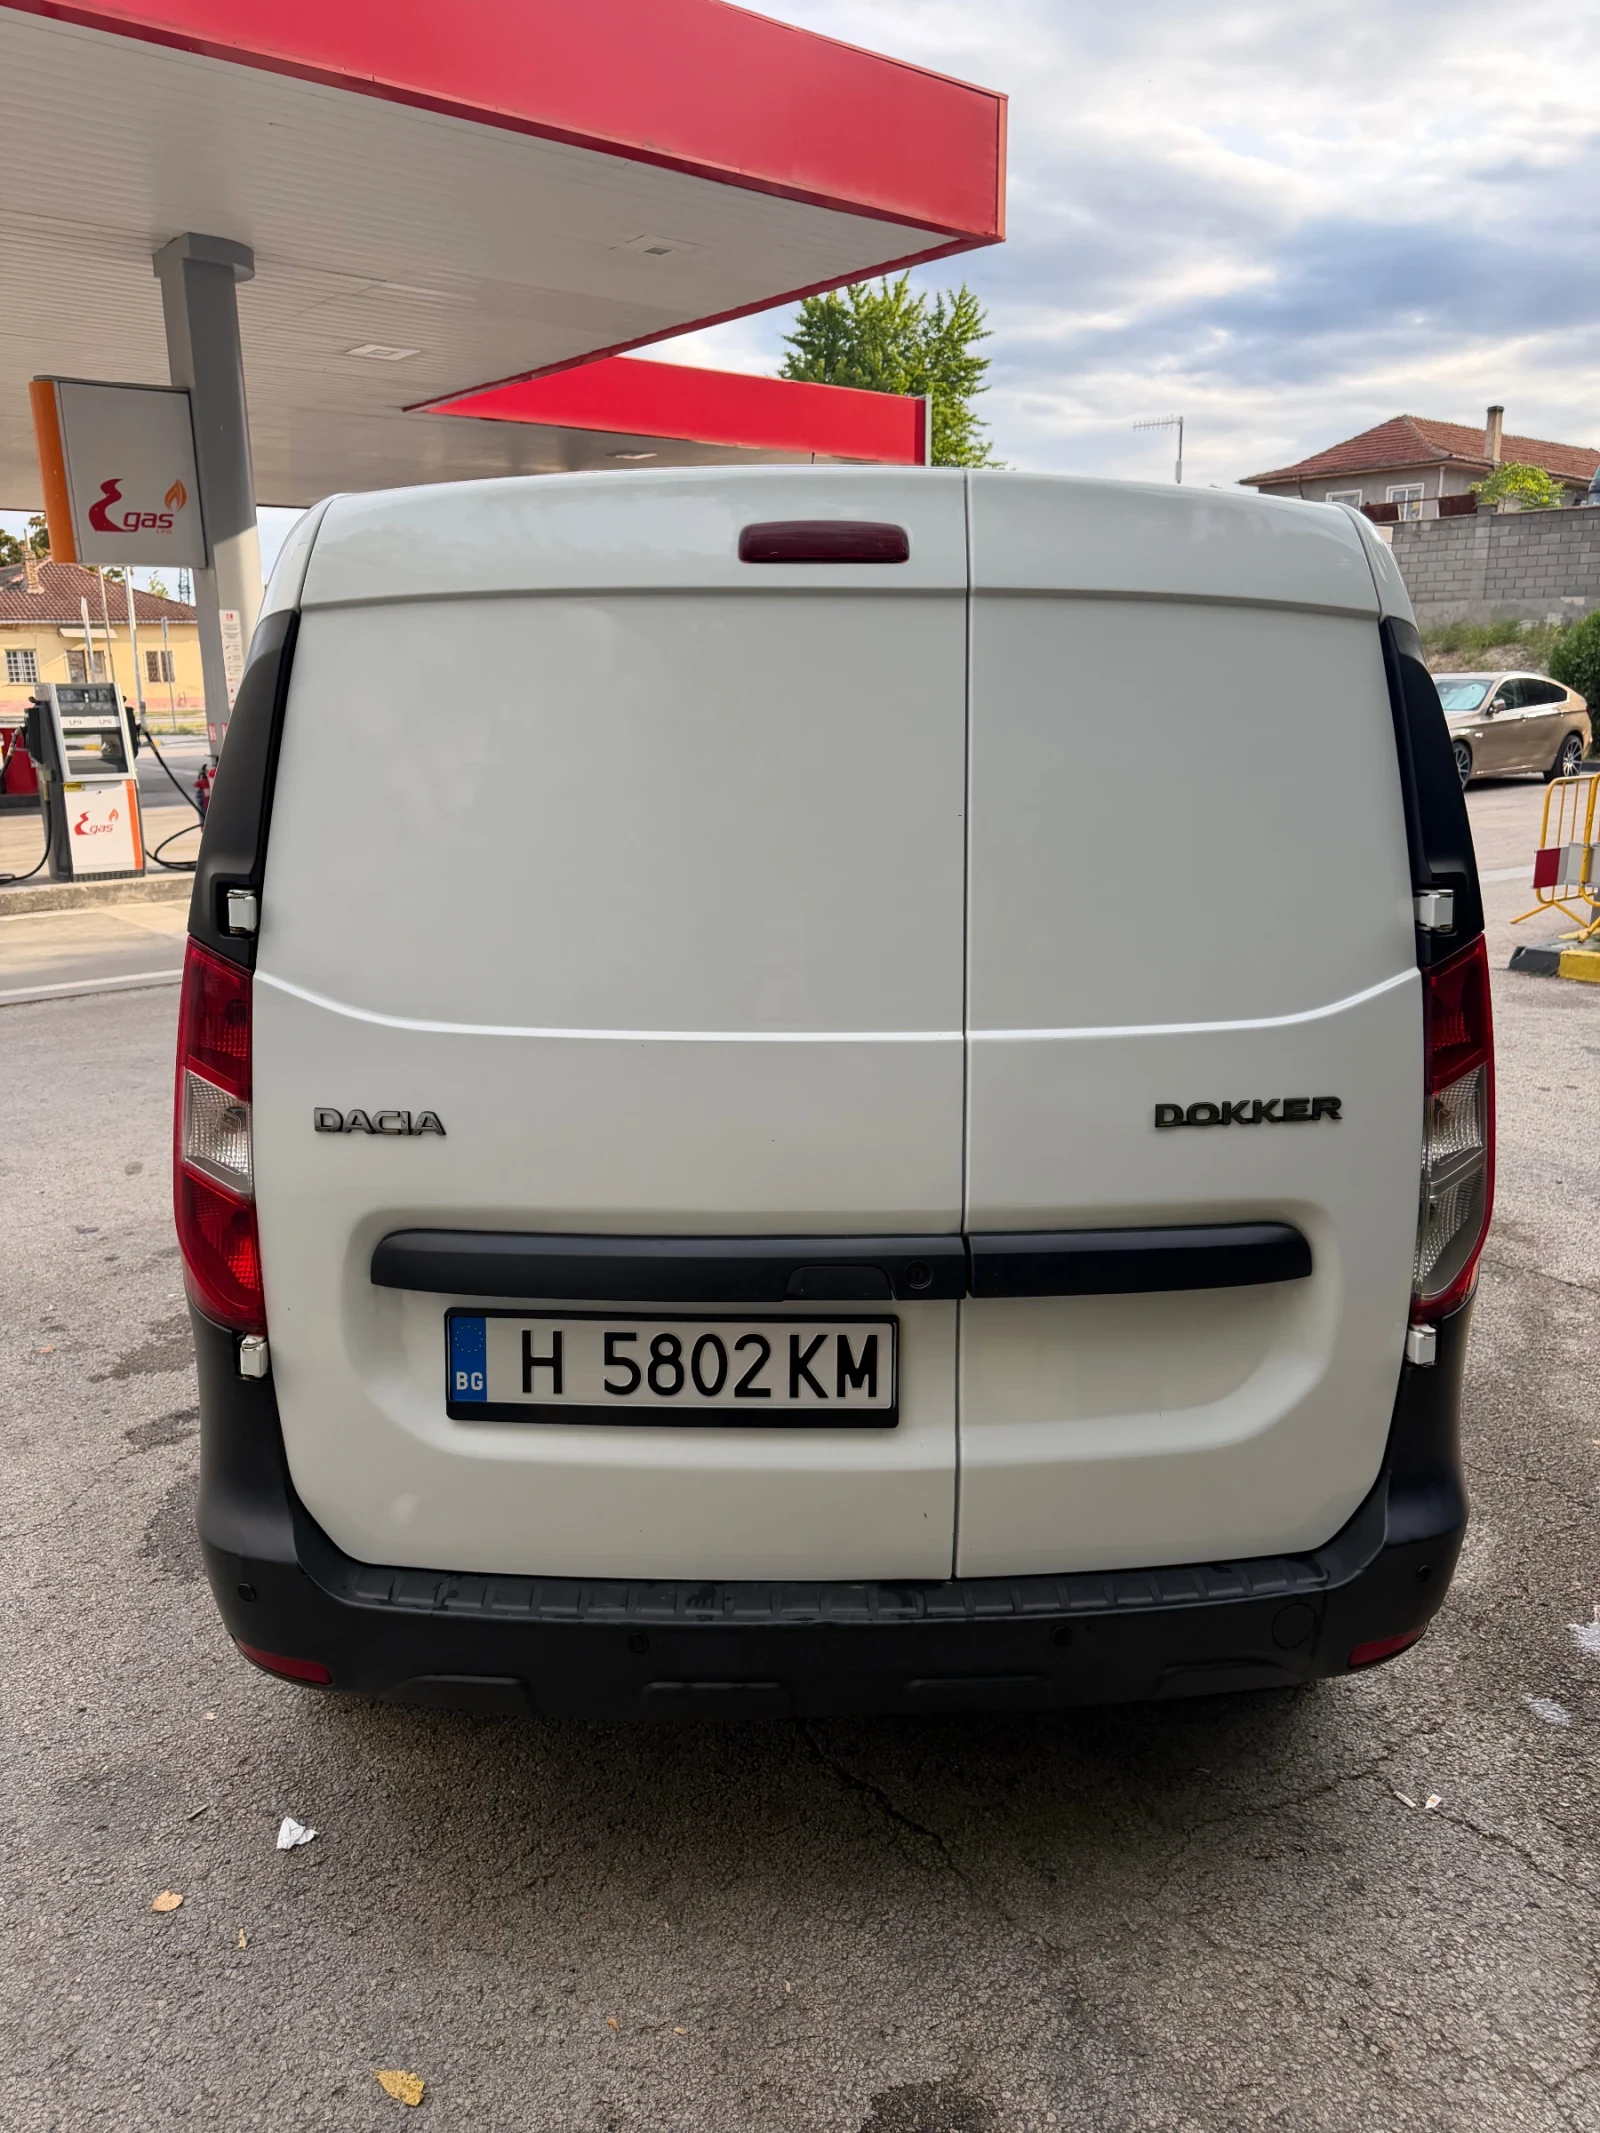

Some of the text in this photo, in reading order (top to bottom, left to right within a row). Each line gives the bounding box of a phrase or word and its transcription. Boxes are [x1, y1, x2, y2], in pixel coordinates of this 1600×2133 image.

[313, 1106, 447, 1136] DACIA
[1154, 1096, 1342, 1128] DOKKER
[521, 1329, 563, 1395] H
[456, 1371, 484, 1391] BG
